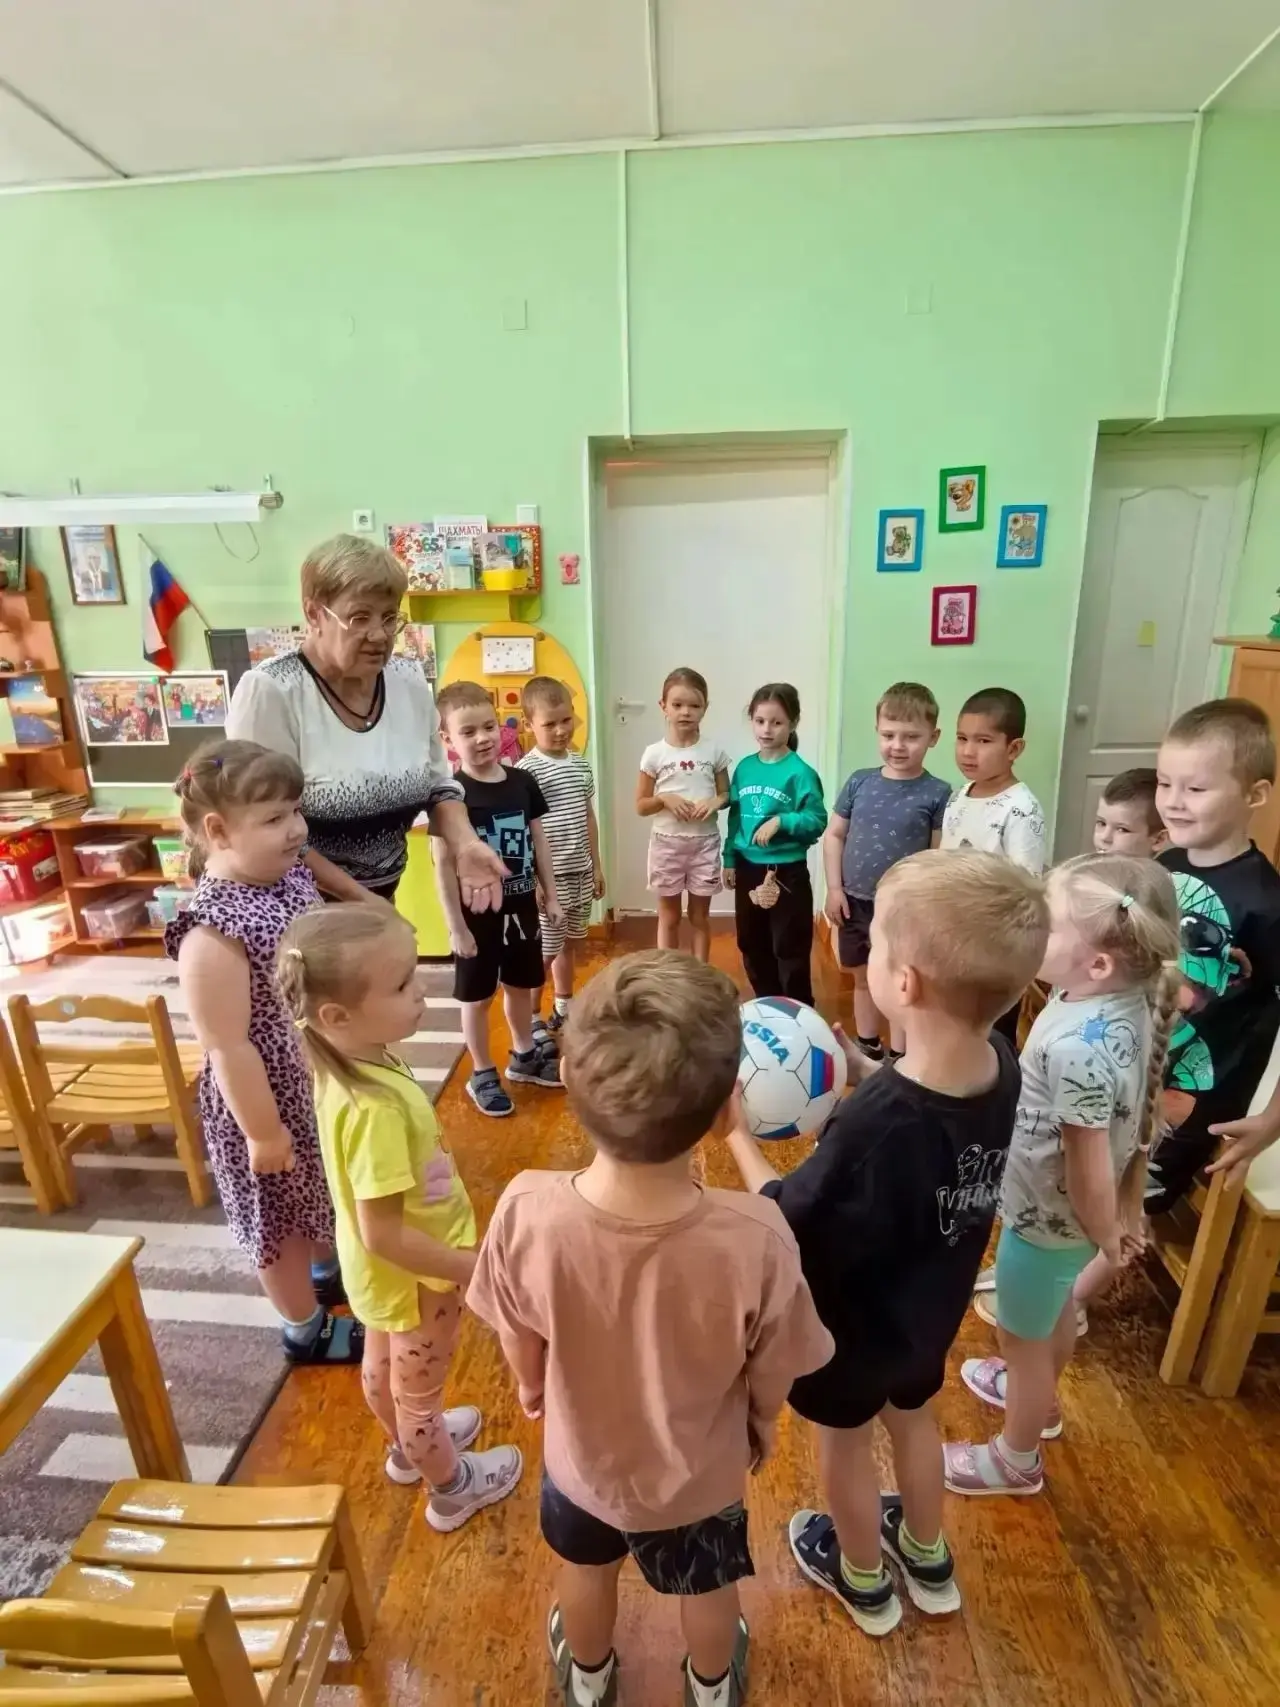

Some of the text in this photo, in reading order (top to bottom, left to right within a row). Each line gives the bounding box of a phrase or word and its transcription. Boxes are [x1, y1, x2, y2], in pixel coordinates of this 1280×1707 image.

[439, 525, 483, 536] ШАХМАТЫ
[413, 536, 440, 554] 365
[744, 1020, 790, 1066] SSIA
